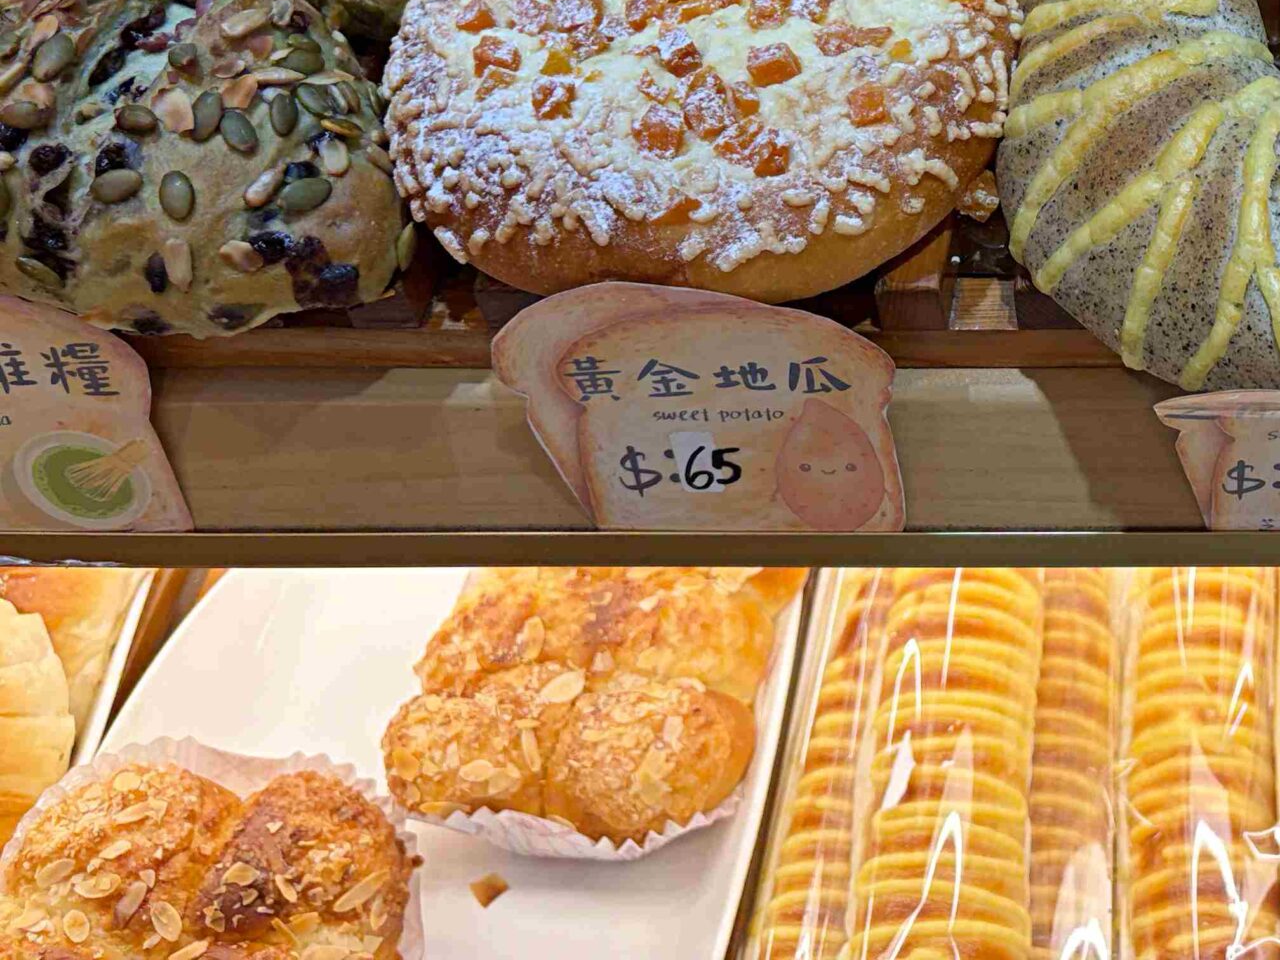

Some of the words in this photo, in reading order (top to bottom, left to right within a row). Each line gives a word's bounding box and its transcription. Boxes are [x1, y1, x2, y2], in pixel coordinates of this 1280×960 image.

[563, 356, 852, 401] 黃金地瓜
[652, 408, 709, 422] sweet
[720, 408, 785, 423] potato
